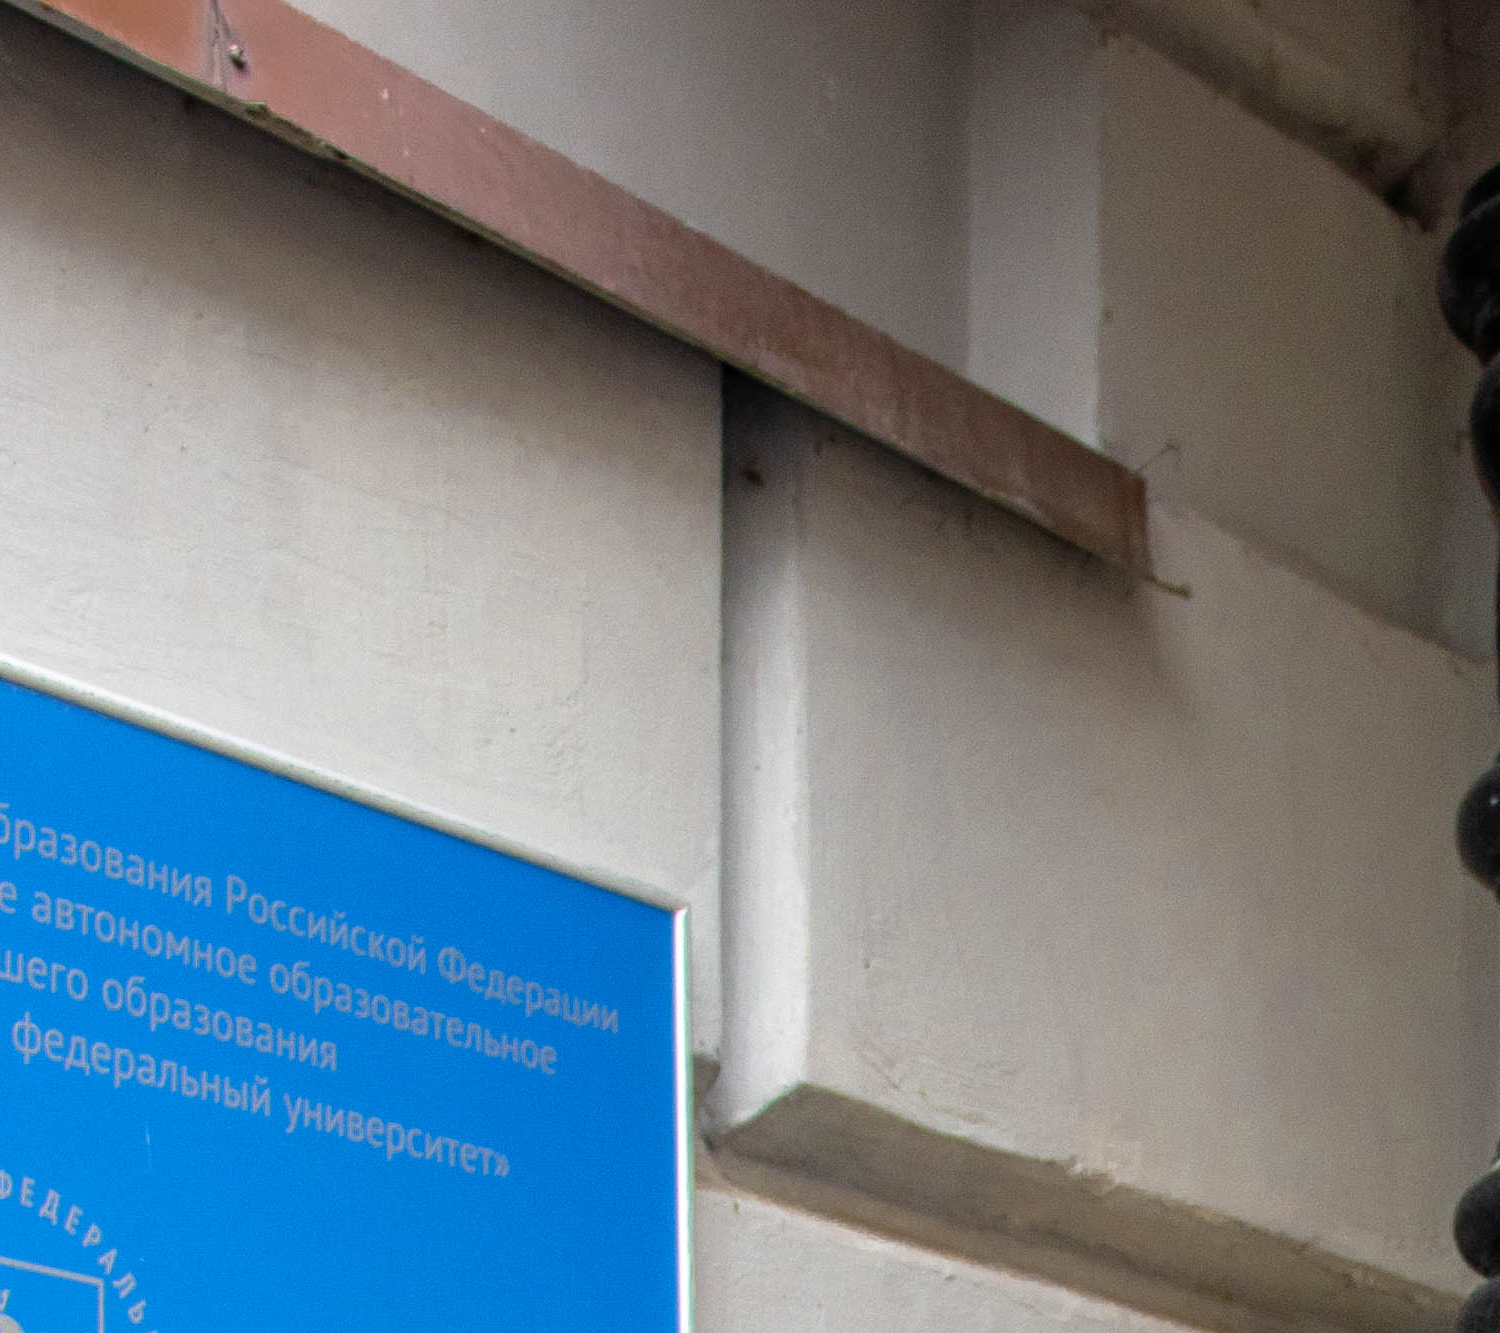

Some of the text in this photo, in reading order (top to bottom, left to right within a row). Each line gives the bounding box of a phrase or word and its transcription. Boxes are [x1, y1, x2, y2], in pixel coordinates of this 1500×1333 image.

[31, 892, 256, 984] автономное
[270, 962, 556, 1074] образовательное
[102, 976, 336, 1070] образования
[226, 875, 426, 973] Российской
[438, 947, 618, 1032] Федерации
[12, 1013, 270, 1116] федеральный
[284, 1094, 509, 1177] университет»
